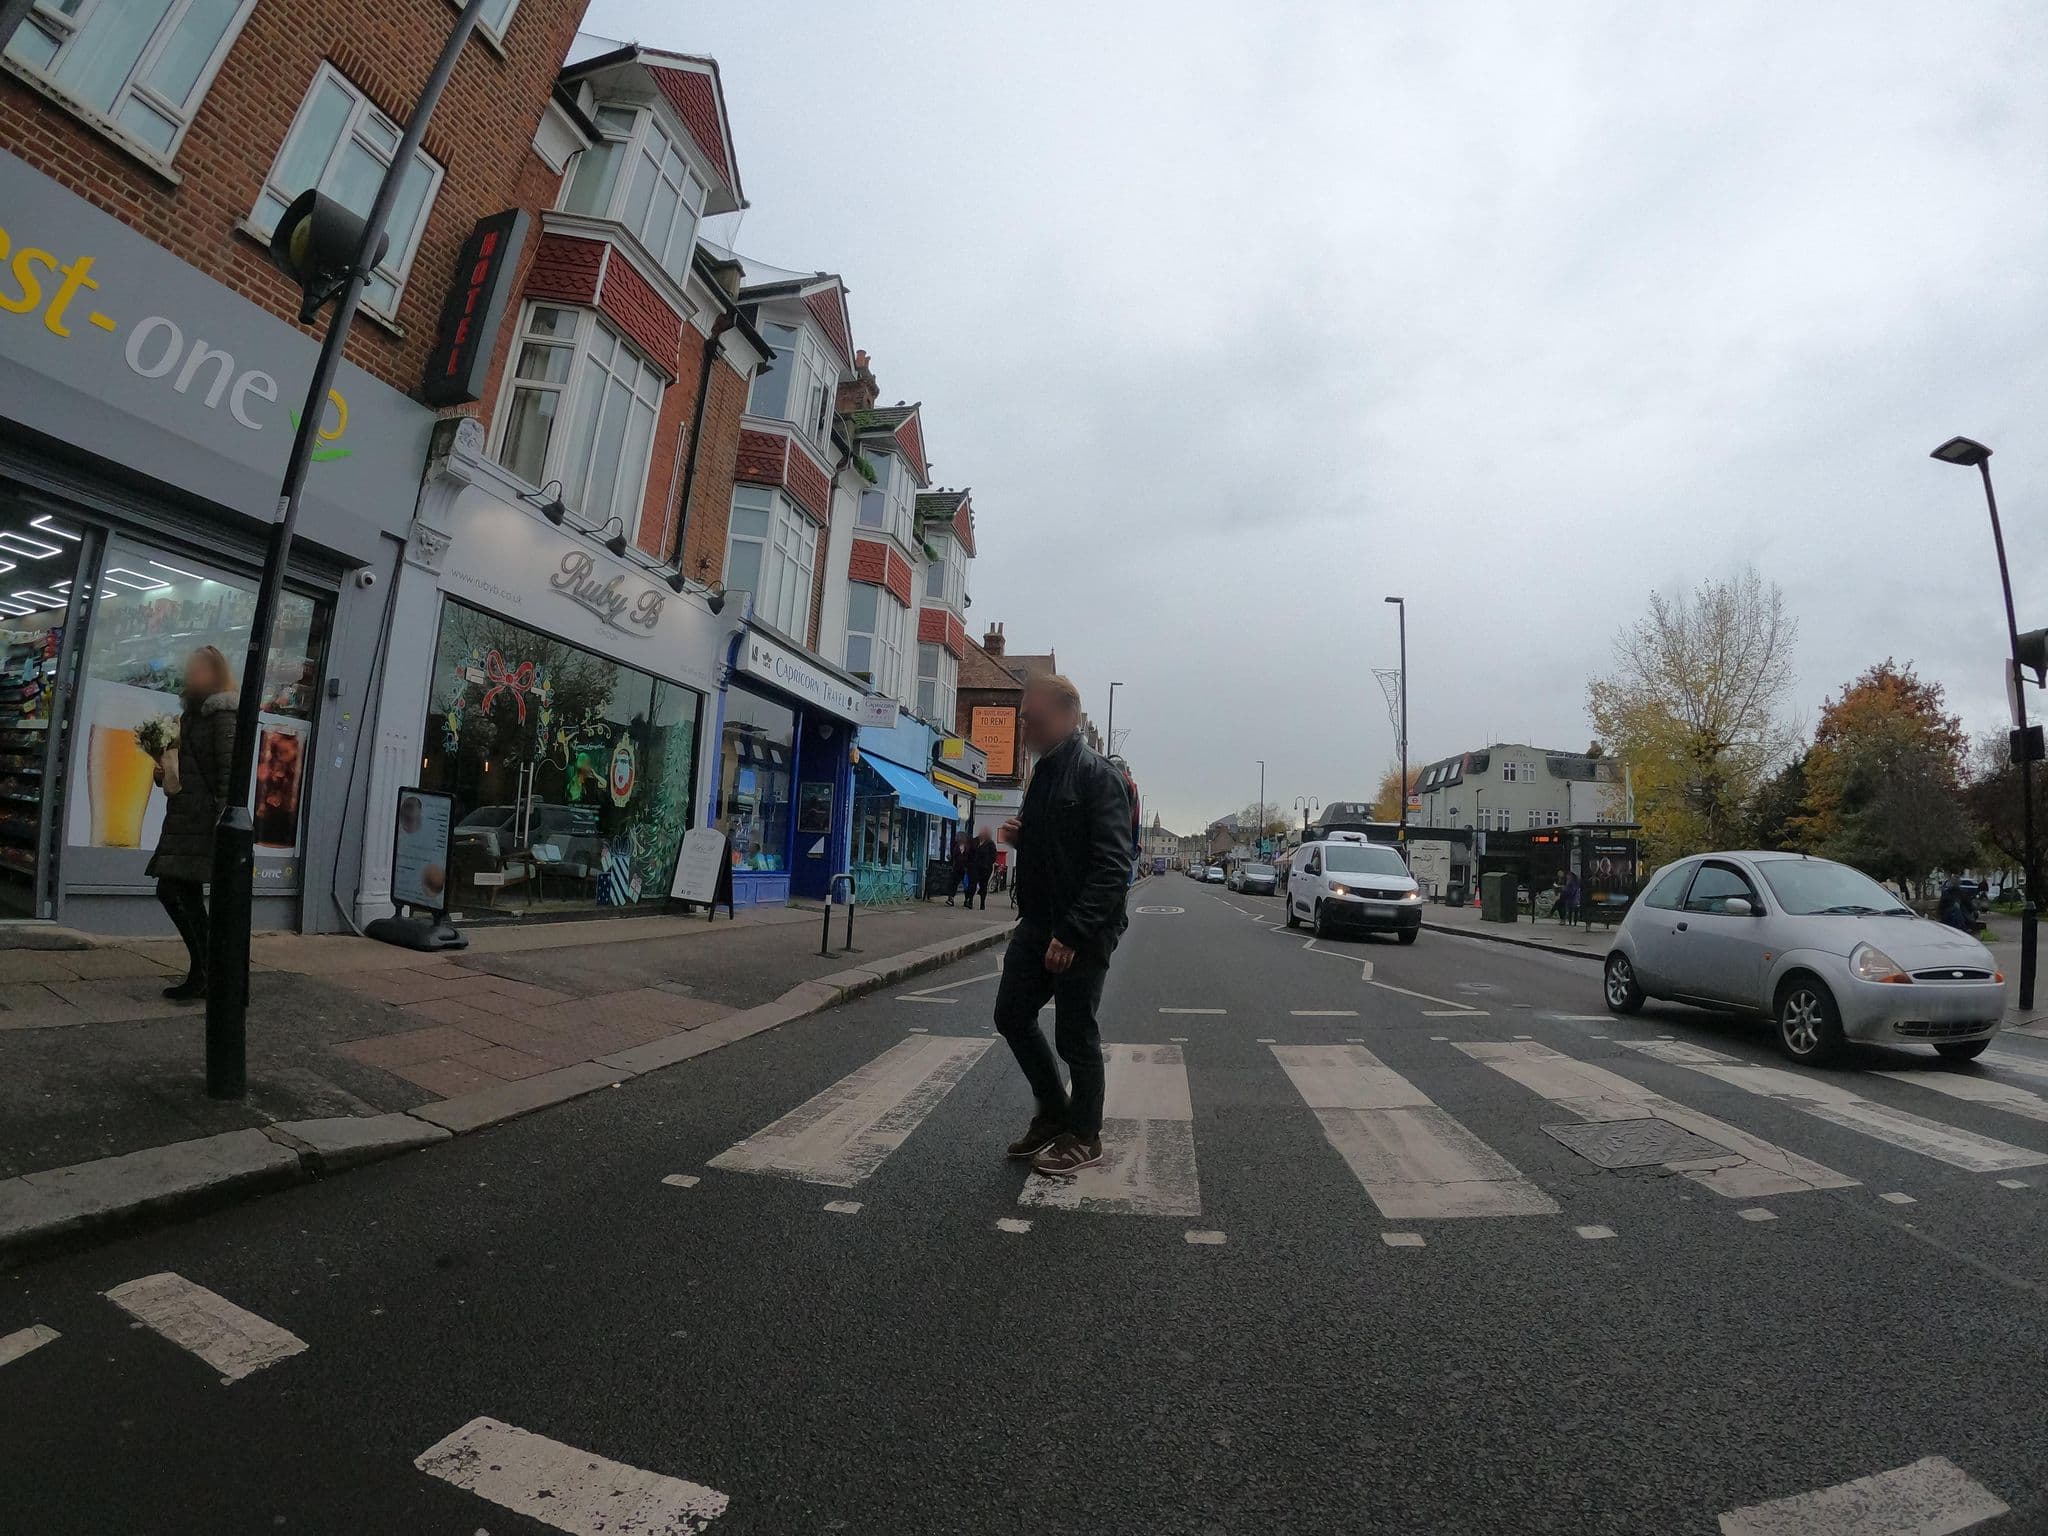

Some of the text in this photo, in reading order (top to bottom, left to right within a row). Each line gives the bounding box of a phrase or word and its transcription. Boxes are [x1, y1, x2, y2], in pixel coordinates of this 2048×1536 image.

[447, 231, 498, 376] HOTEL
[551, 551, 665, 629] Ruby B
[981, 717, 1007, 726] TO RENT
